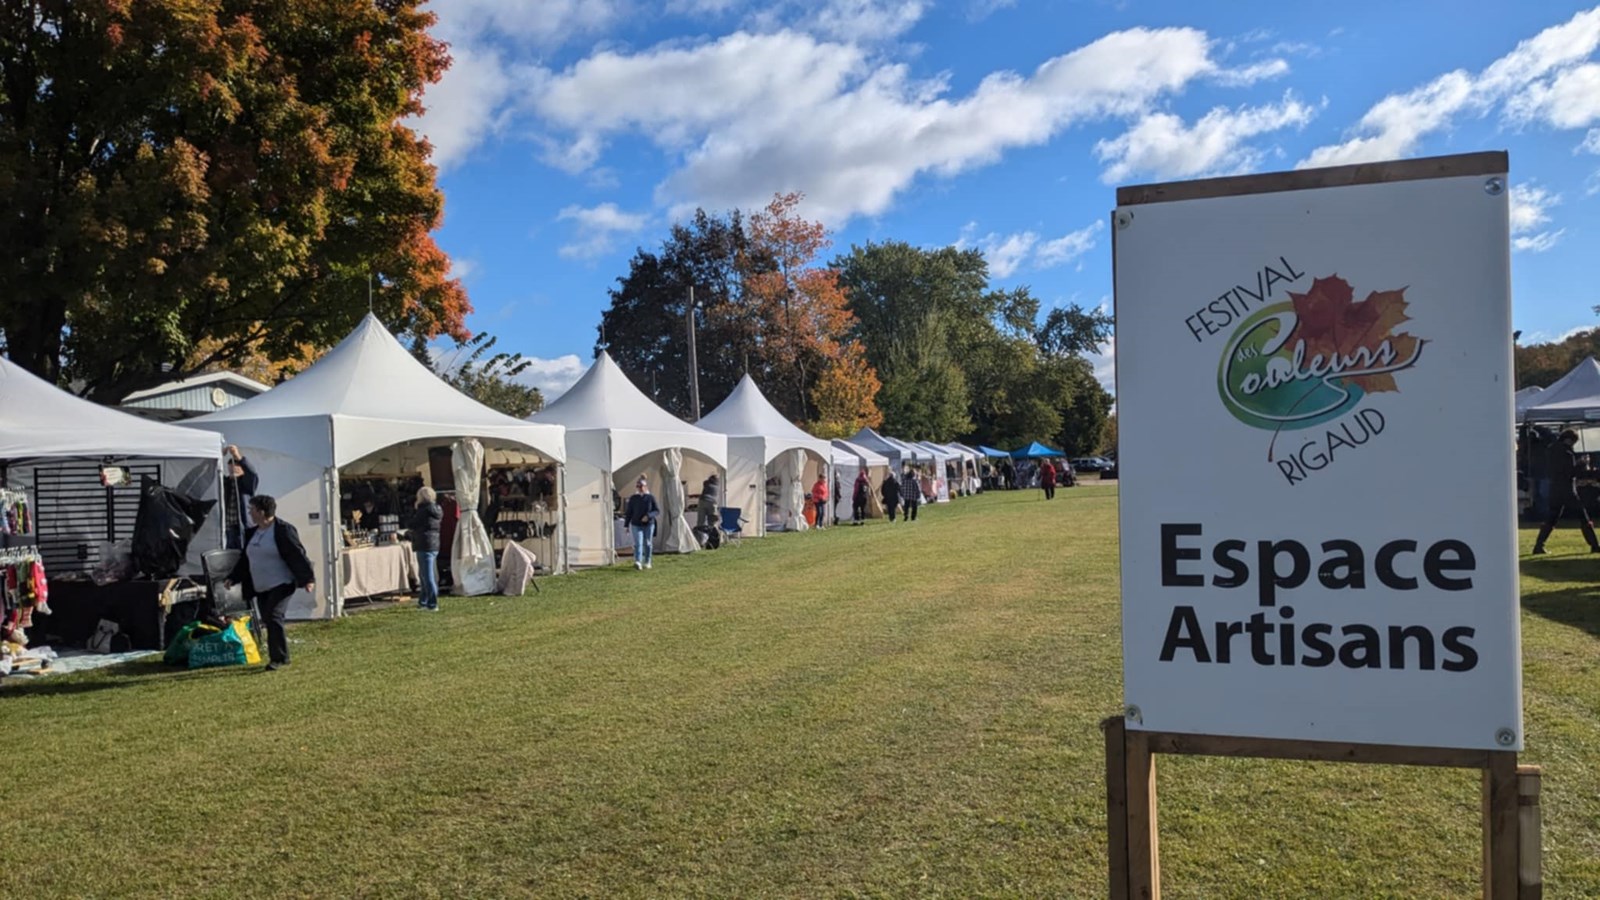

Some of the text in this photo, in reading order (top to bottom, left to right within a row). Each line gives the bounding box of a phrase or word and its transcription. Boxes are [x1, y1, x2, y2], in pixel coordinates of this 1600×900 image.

[1185, 256, 1304, 342] FESTIVAL
[1222, 310, 1424, 421] Couleurs
[1236, 342, 1258, 362] des
[1277, 408, 1385, 485] RIGAUD
[1160, 523, 1476, 606] Espace
[1159, 605, 1478, 672] Artisans
